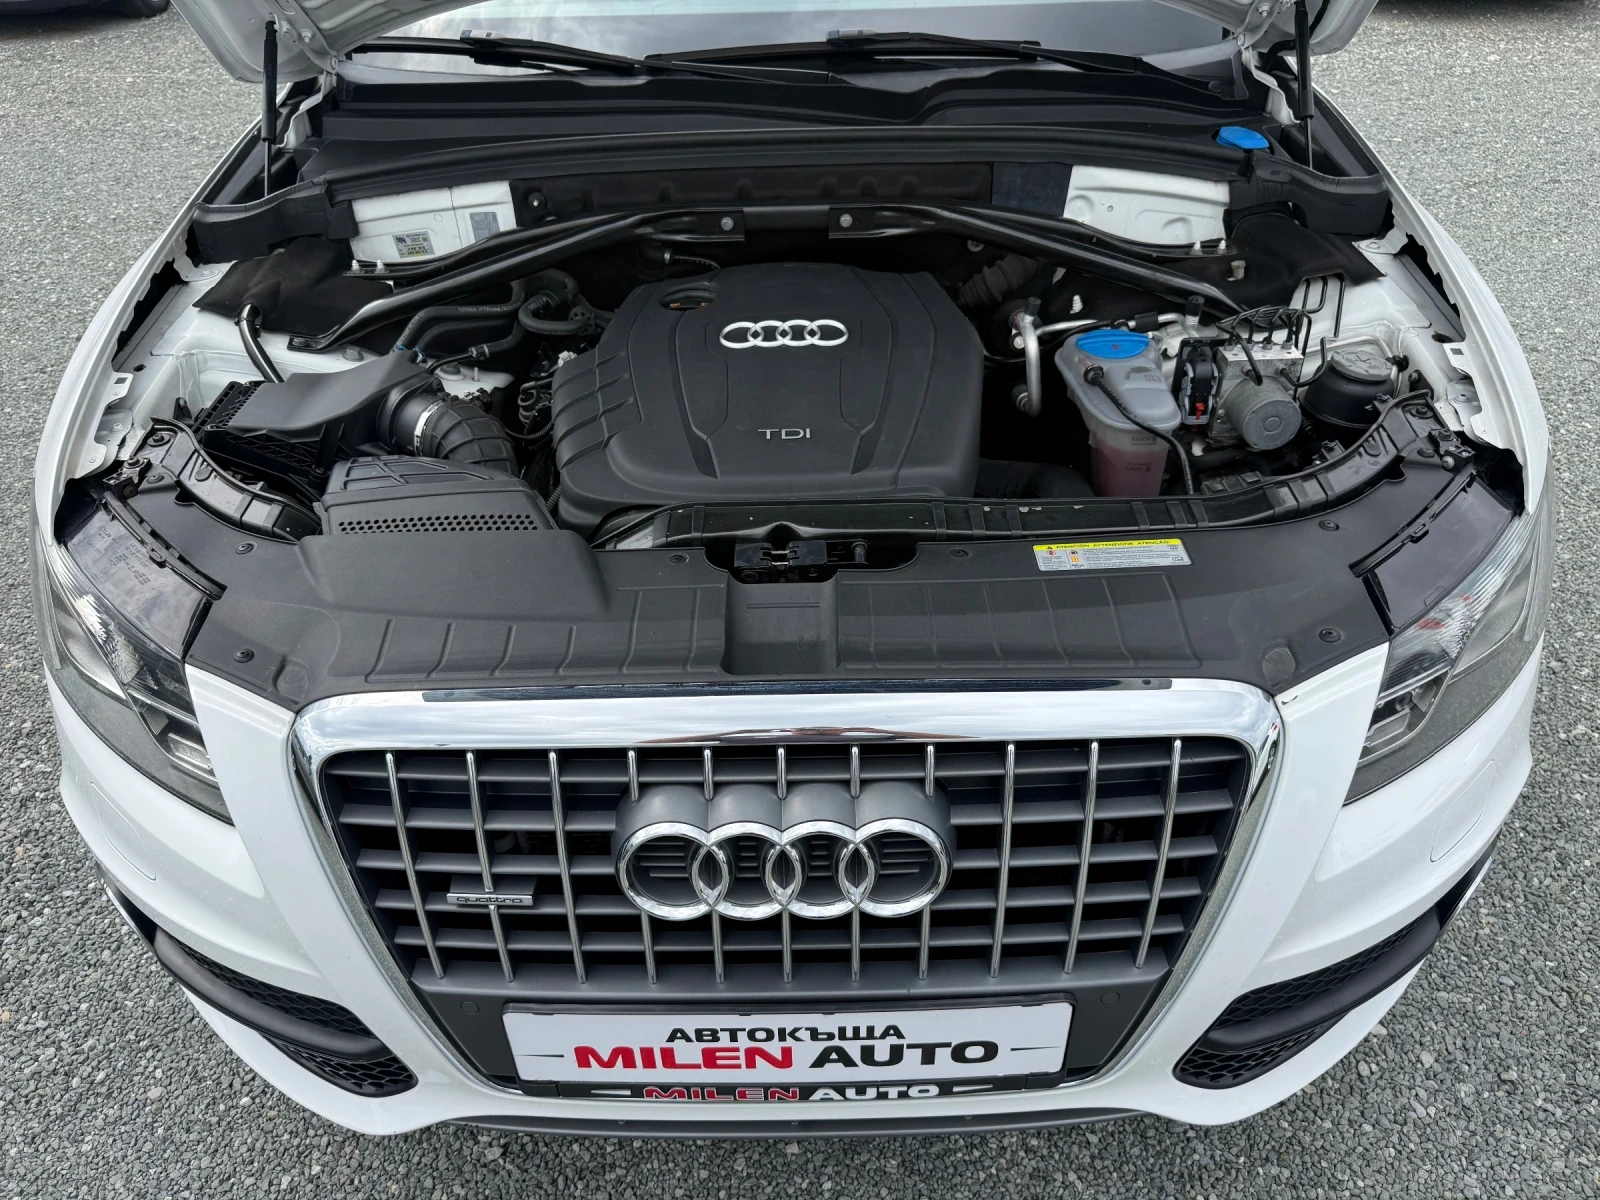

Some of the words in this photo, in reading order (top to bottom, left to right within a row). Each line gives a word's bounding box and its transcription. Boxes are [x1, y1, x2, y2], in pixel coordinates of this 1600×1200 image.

[757, 427, 811, 440] TDI
[456, 896, 523, 904] quattro
[573, 1046, 793, 1069] MILEN
[809, 1040, 999, 1069] AUTO
[643, 1086, 800, 1101] MILEN
[808, 1084, 940, 1101] AUTO
